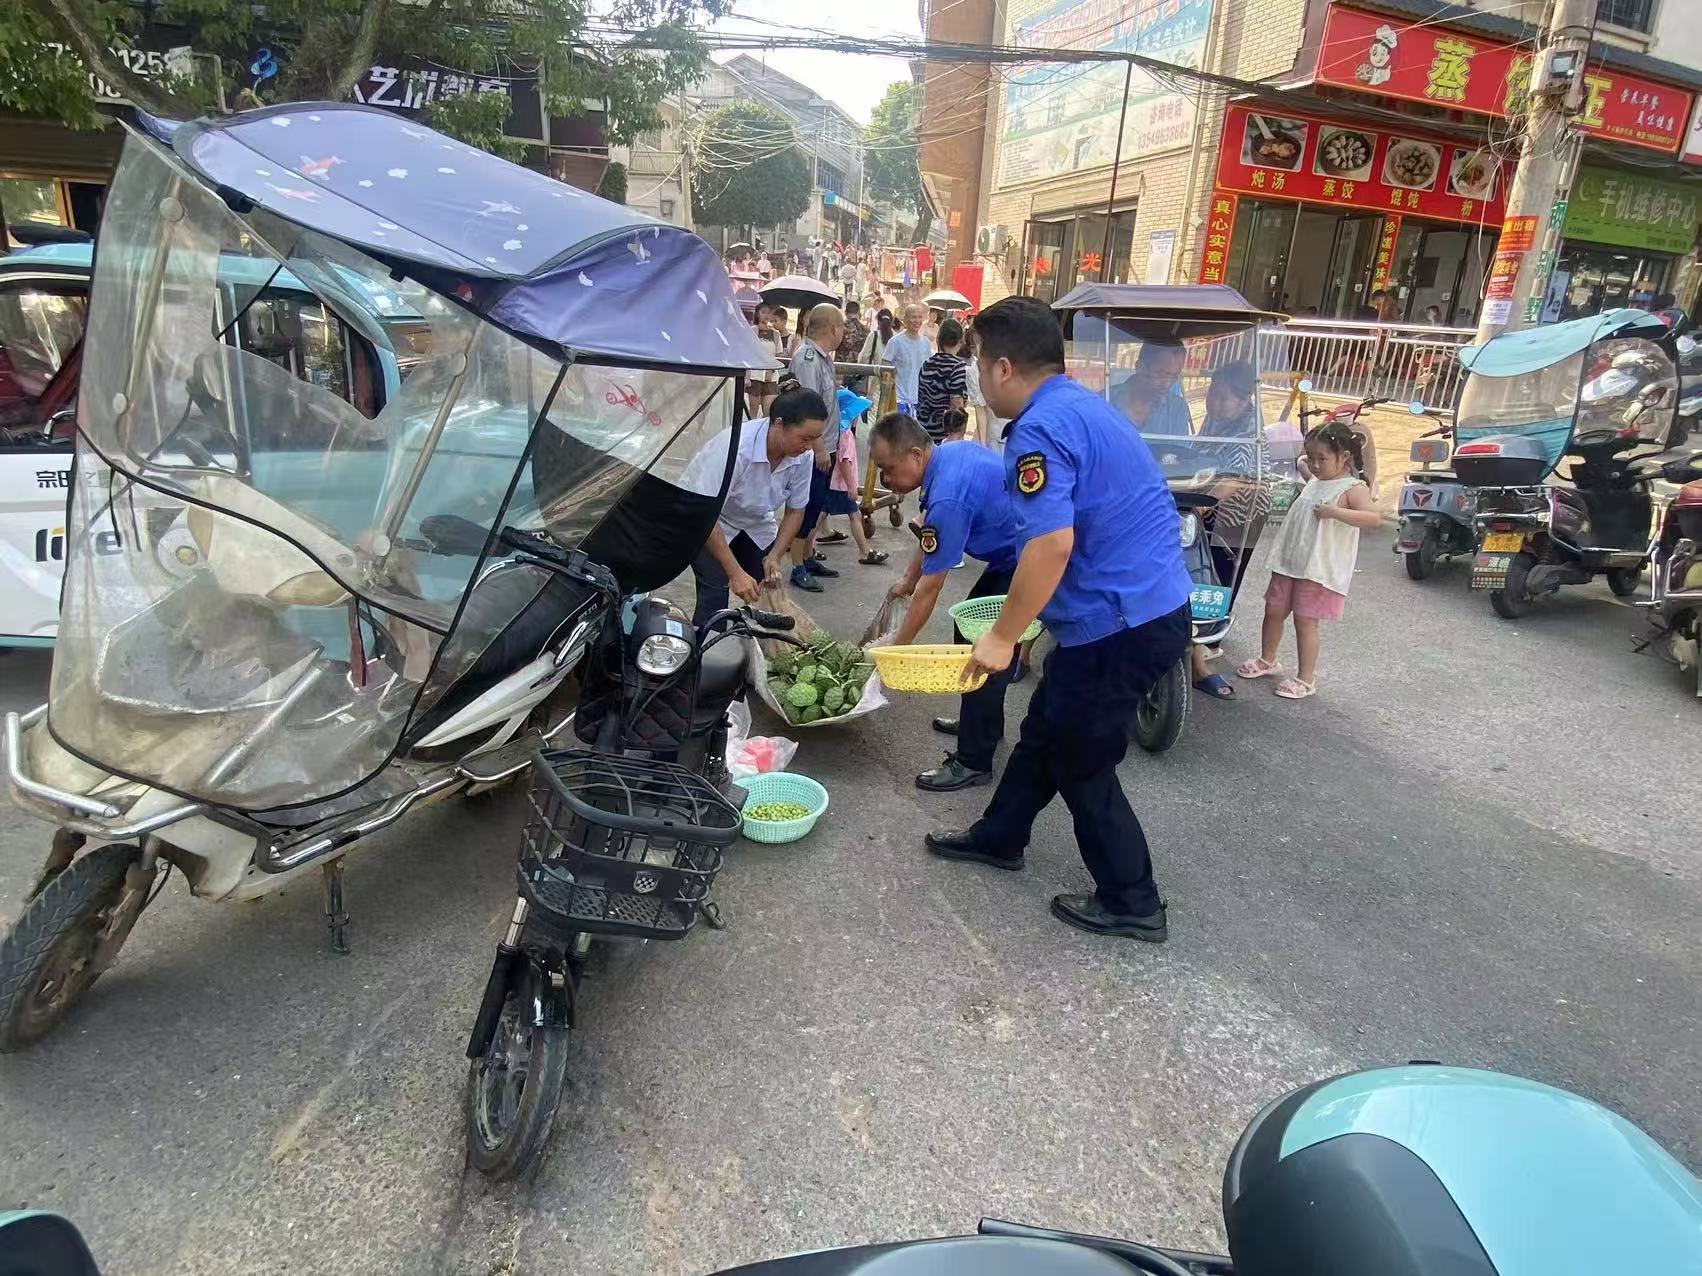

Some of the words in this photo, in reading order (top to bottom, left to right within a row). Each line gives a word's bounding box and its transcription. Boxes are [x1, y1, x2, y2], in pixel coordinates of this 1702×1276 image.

[1250, 169, 1286, 190] 炖汤
[1321, 178, 1354, 200] 蒸饺
[1390, 189, 1419, 208] 馄饨
[1599, 180, 1697, 231] 手机维修中心
[1203, 199, 1232, 281] 真心实意当
